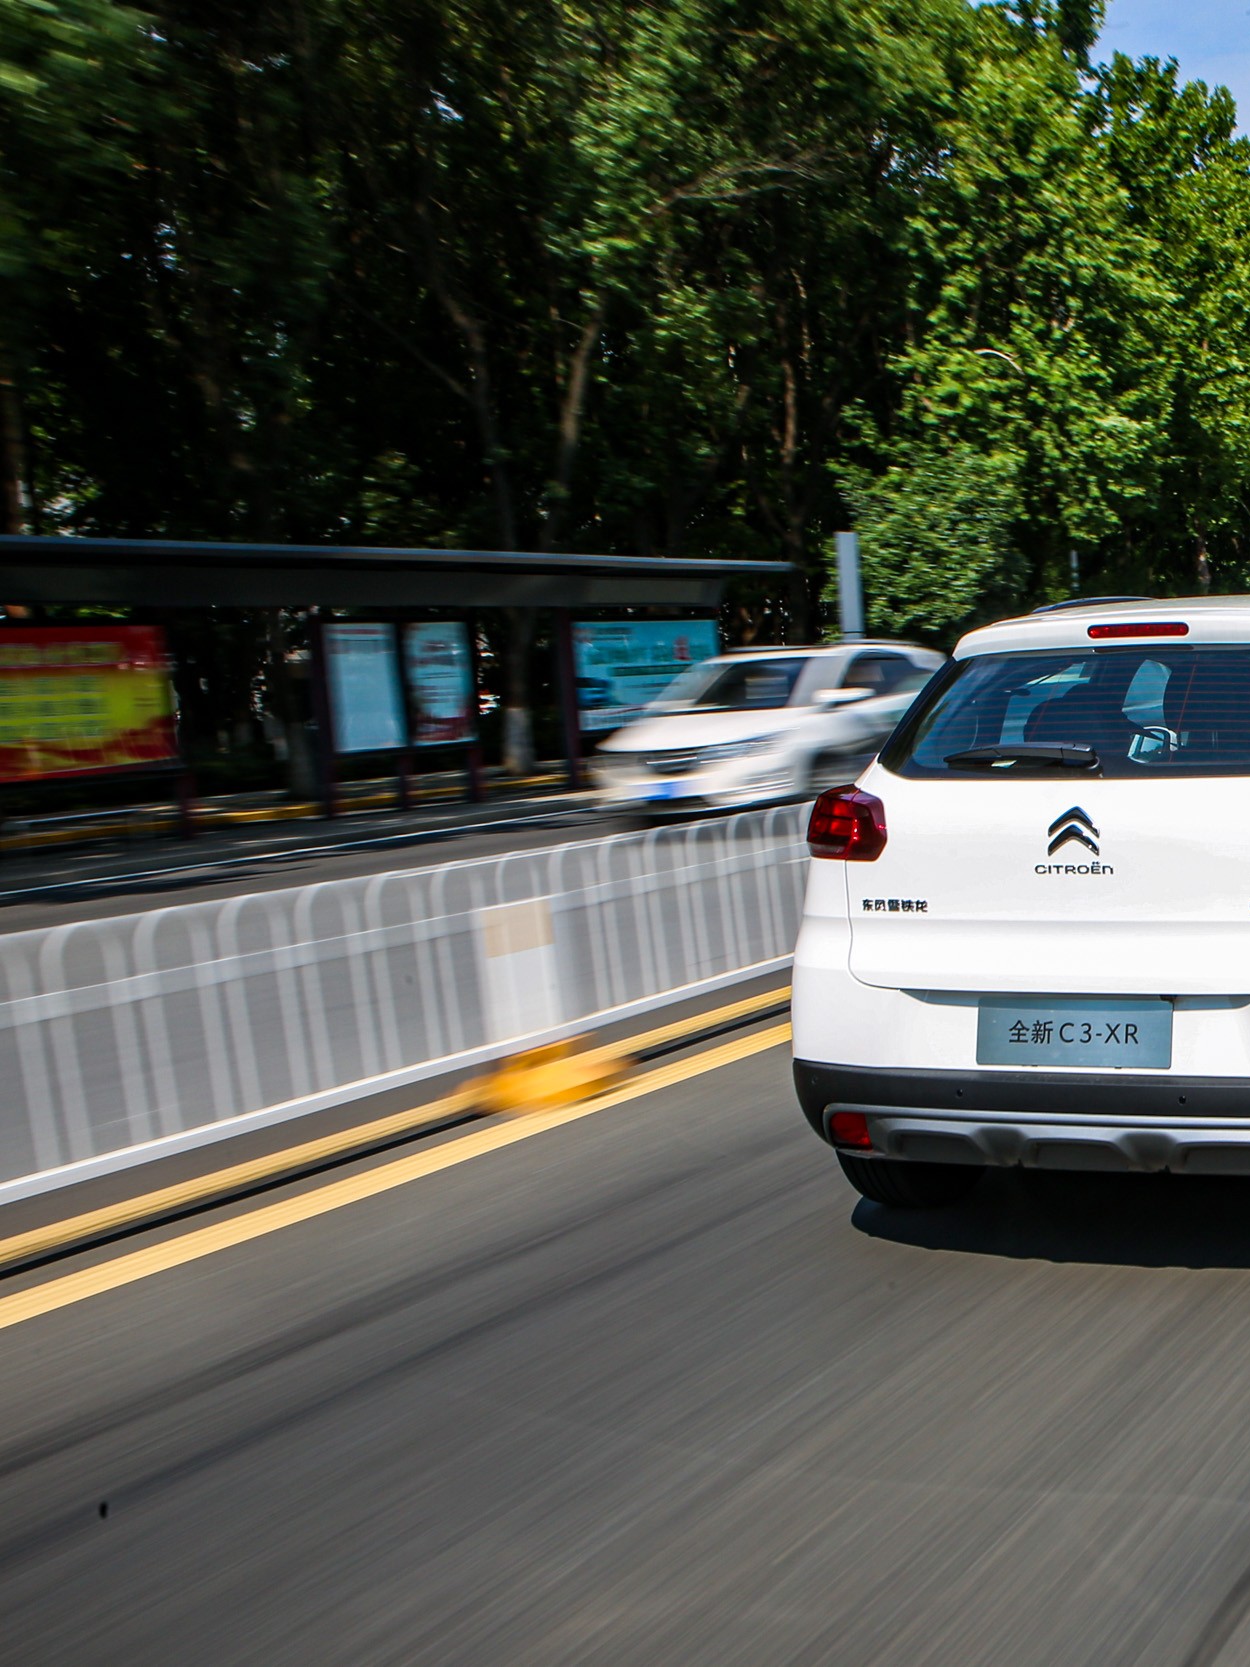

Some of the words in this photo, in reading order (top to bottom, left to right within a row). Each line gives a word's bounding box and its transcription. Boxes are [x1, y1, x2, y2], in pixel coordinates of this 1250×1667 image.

[862, 898, 928, 913] 东风雪铁龙
